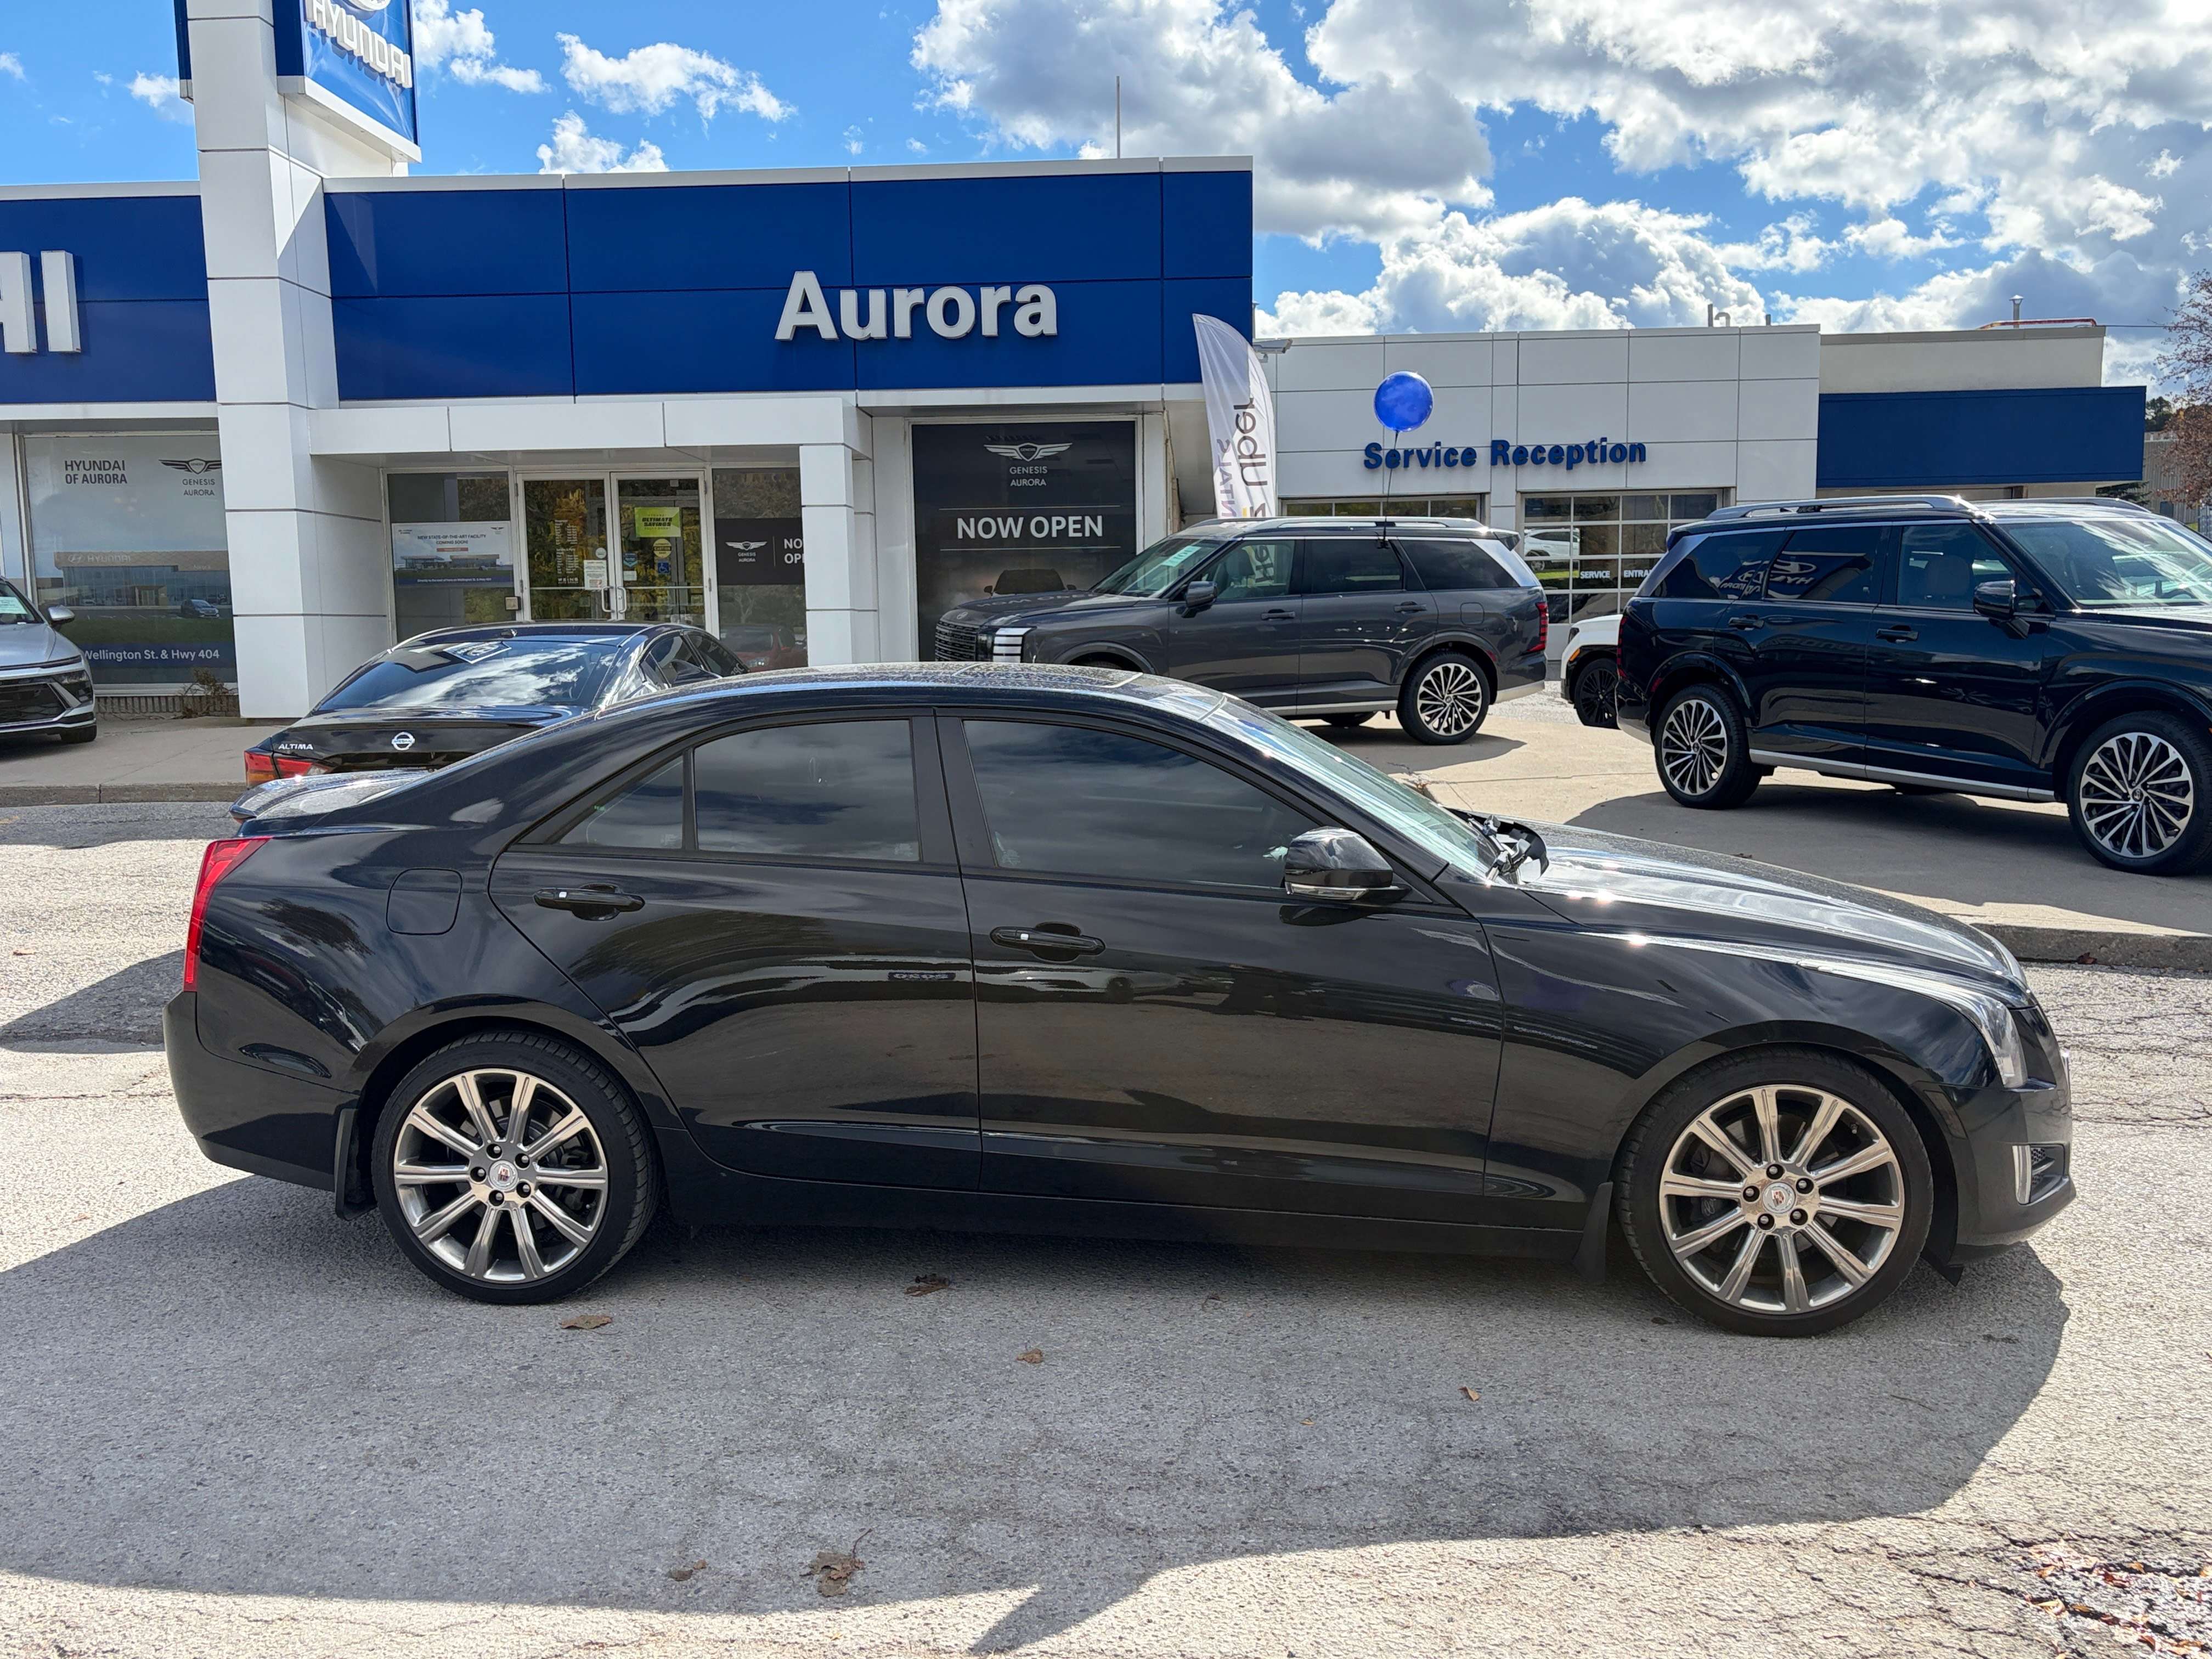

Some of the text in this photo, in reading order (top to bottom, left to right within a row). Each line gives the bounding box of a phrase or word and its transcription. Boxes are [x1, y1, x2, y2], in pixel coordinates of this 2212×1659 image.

[306, 0, 413, 88] HYUNDAI
[775, 270, 1058, 341] Aurora
[1364, 437, 1646, 470] Service Reception
[65, 460, 126, 471] HYUNDAI
[1009, 466, 1048, 475] GENESIS
[65, 473, 127, 484] OF AURORA
[1010, 478, 1047, 487] AURORA
[957, 515, 1103, 539] NOW OPEN
[783, 538, 803, 549] NO
[784, 553, 805, 564] OP
[1580, 569, 1653, 579] SERVICE ENTRA
[83, 649, 220, 662] Wellington St. & Hwy 404
